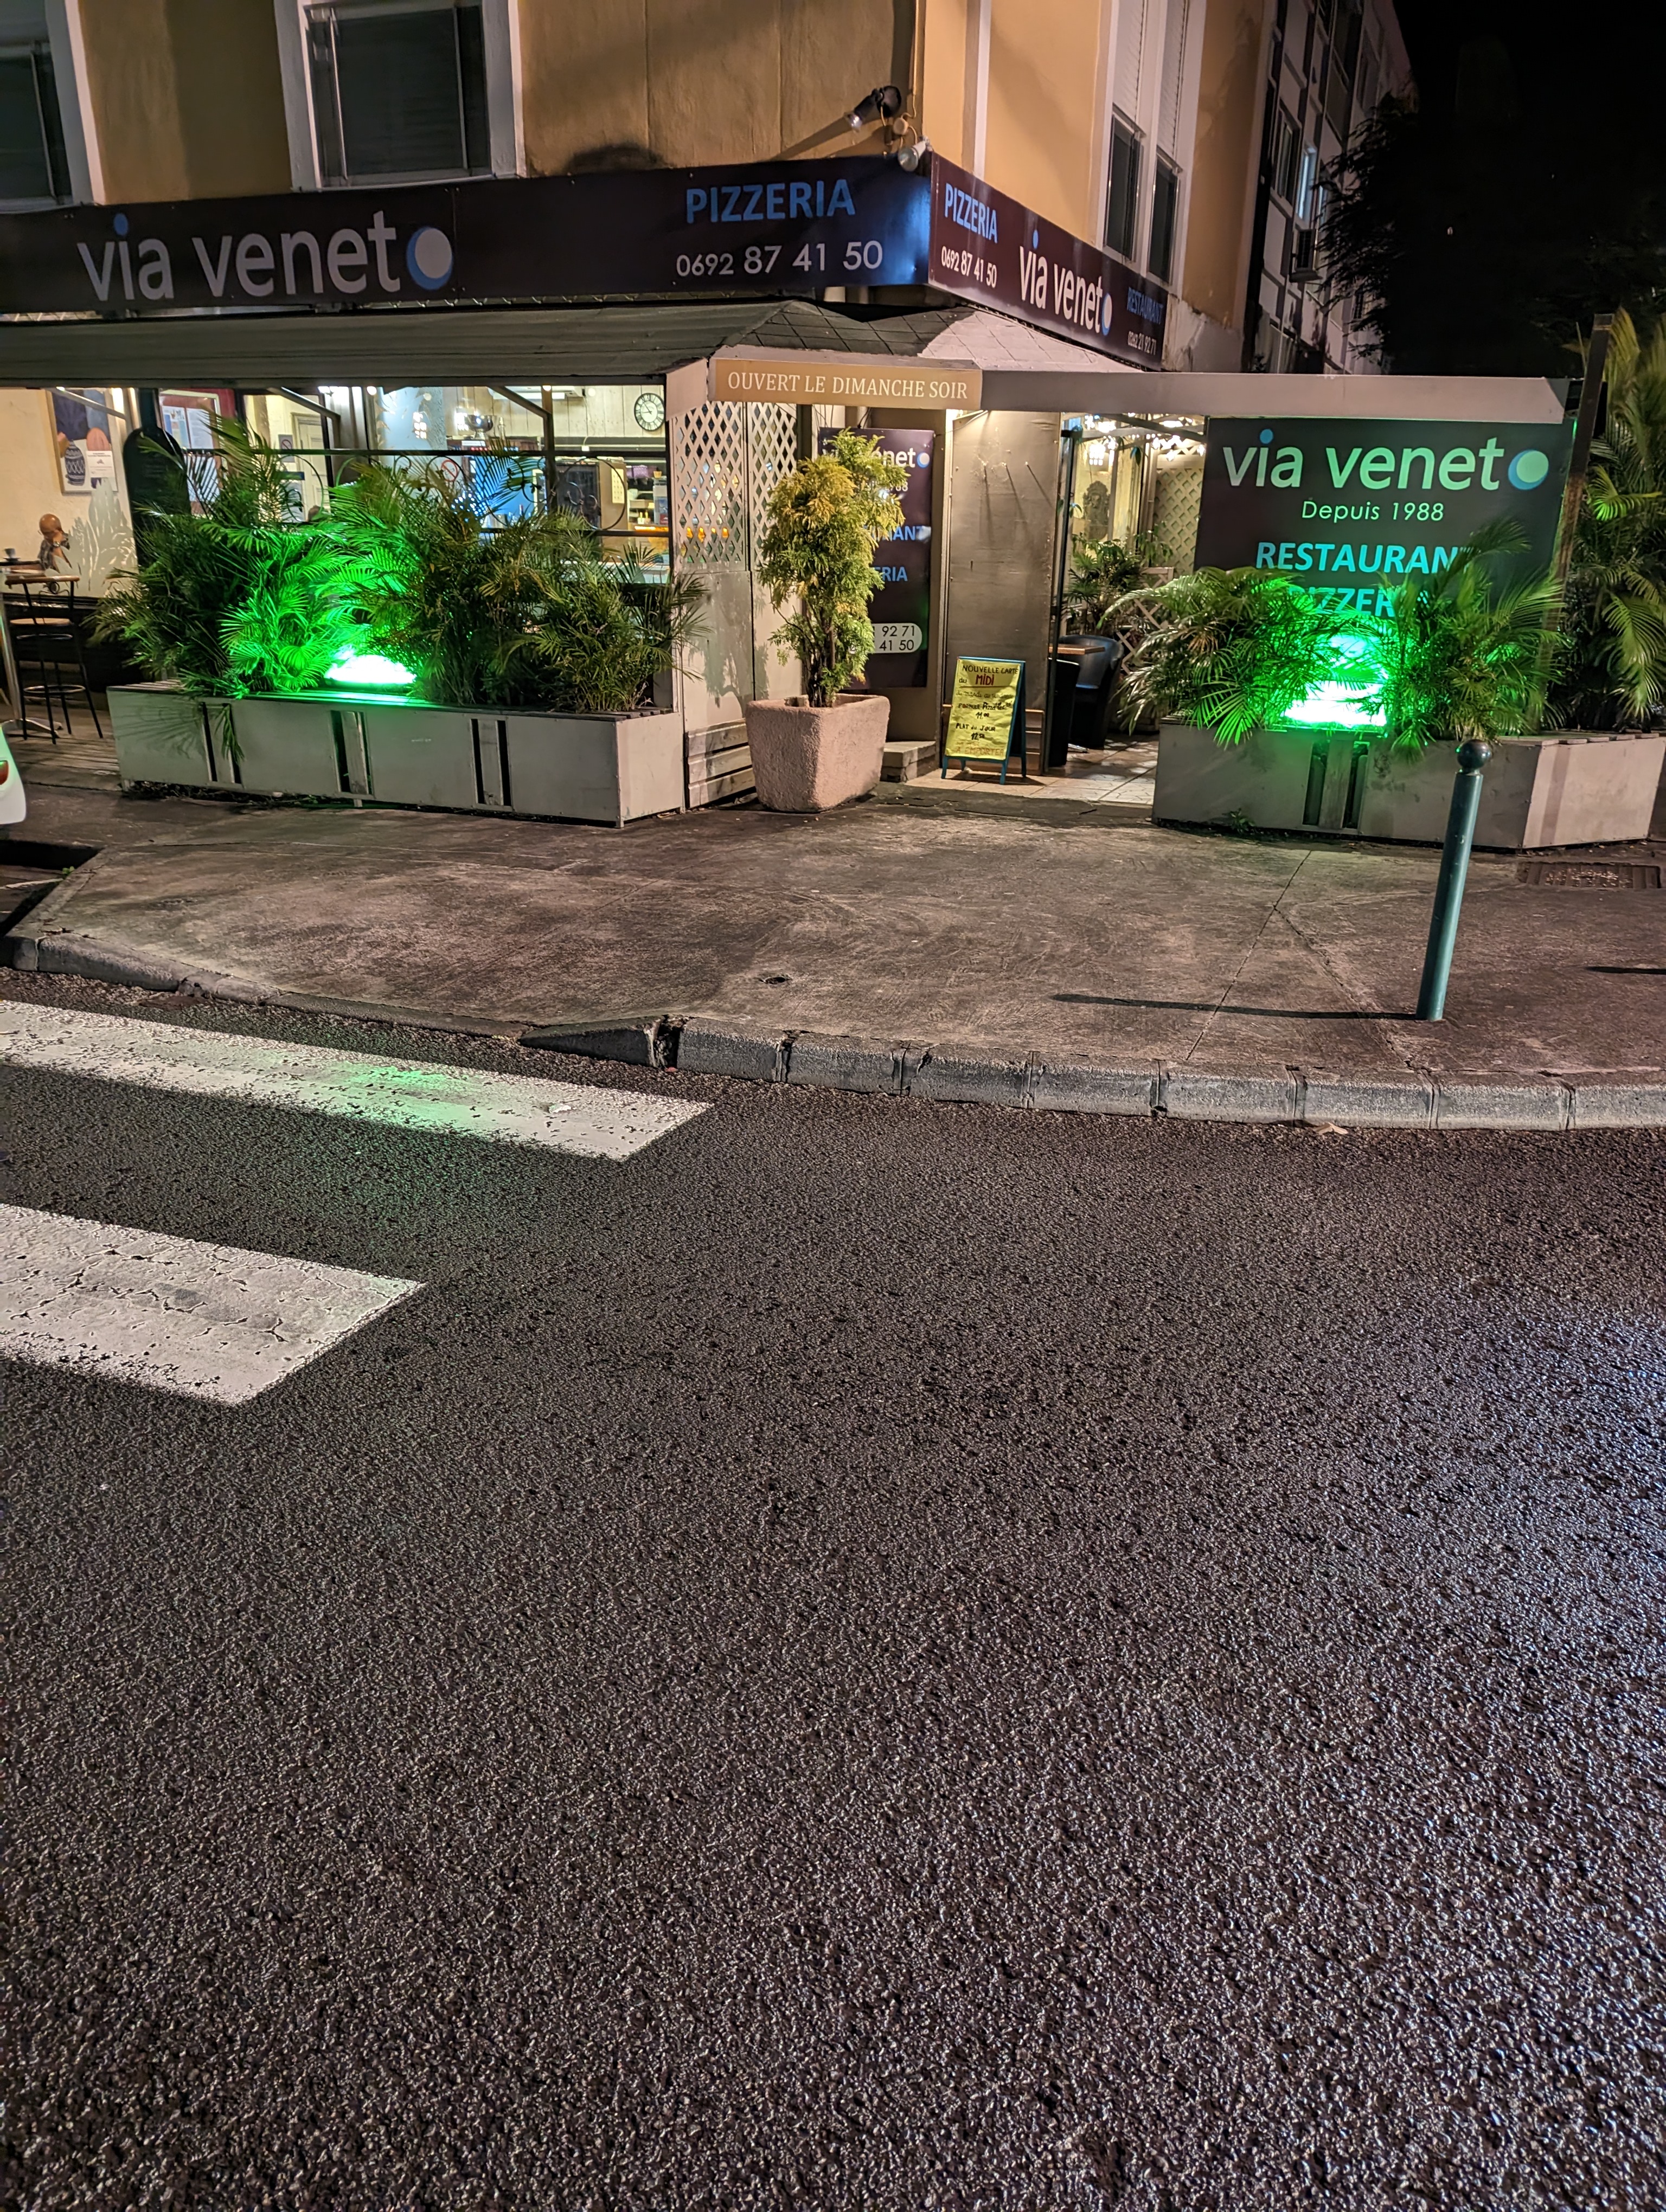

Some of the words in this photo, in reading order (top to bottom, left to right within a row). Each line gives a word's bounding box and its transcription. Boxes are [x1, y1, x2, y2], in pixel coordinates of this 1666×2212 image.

[686, 179, 855, 224] PIZZERIA
[944, 182, 998, 243] PIZZERIA
[78, 212, 174, 301] via
[192, 210, 453, 298] veneto
[676, 253, 734, 277] 0692
[744, 245, 782, 274] 87
[792, 243, 826, 272] 41
[843, 240, 883, 271] 50
[941, 246, 959, 272] 0692
[960, 250, 973, 278] 87
[973, 257, 984, 284] 41
[986, 262, 997, 288] 50
[1020, 229, 1048, 310] via
[1054, 263, 1113, 336] veneto
[1127, 287, 1164, 324] RESTAURANT
[728, 371, 799, 392] OUVERT
[804, 375, 825, 394] LE
[832, 376, 925, 398] DIMANCHE
[928, 381, 968, 400] SOIR
[1223, 429, 1304, 488] via
[1325, 437, 1549, 491] veneto
[1302, 501, 1380, 523] Depuis
[1392, 502, 1445, 521] 1988
[879, 640, 893, 651] 41
[899, 639, 914, 651] 50
[882, 626, 898, 637] 92
[902, 625, 915, 636] 71
[962, 665, 999, 674] NOUVELLE
[965, 747, 1004, 756] EMPORTER
